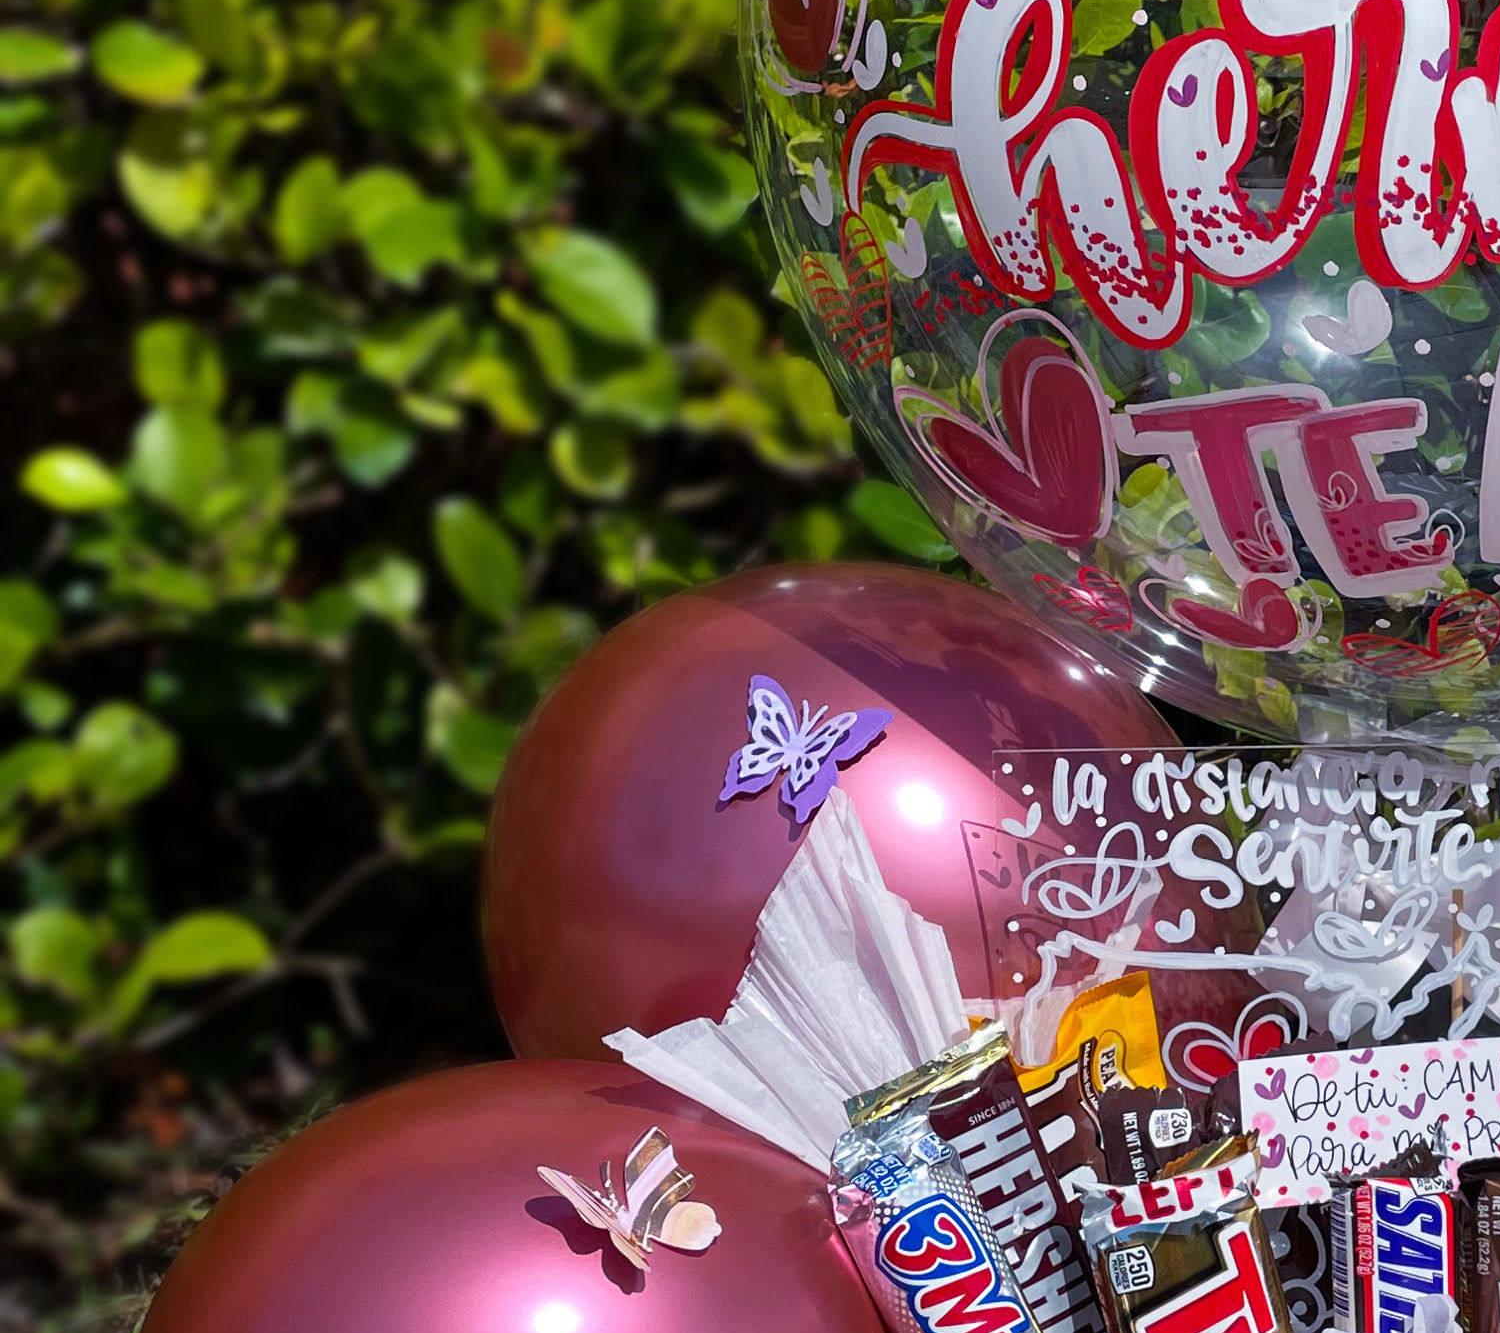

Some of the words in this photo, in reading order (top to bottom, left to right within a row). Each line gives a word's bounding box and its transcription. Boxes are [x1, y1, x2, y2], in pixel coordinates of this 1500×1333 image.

[1114, 385, 1464, 598] TE
[1133, 751, 1423, 823] distancia
[1283, 1072, 1342, 1123] De
[967, 1106, 998, 1127] SINCE
[1122, 1111, 1139, 1131] NET
[1160, 1113, 1171, 1142] CALORIES
[1170, 1111, 1188, 1140] 230
[1125, 1130, 1142, 1148] WT
[1129, 1148, 1147, 1170] 1.69
[1134, 1170, 1150, 1185] OZ
[1356, 1184, 1372, 1200] NET
[1356, 1200, 1372, 1214] WT
[1477, 1195, 1490, 1218] 1.84
[1357, 1233, 1373, 1246] OZ
[1477, 1220, 1491, 1236] OZ
[882, 1214, 979, 1275] 3
[1475, 1237, 1491, 1277] (52.2g)
[1115, 1253, 1131, 1290] CALORIES
[1126, 1250, 1152, 1288] 250
